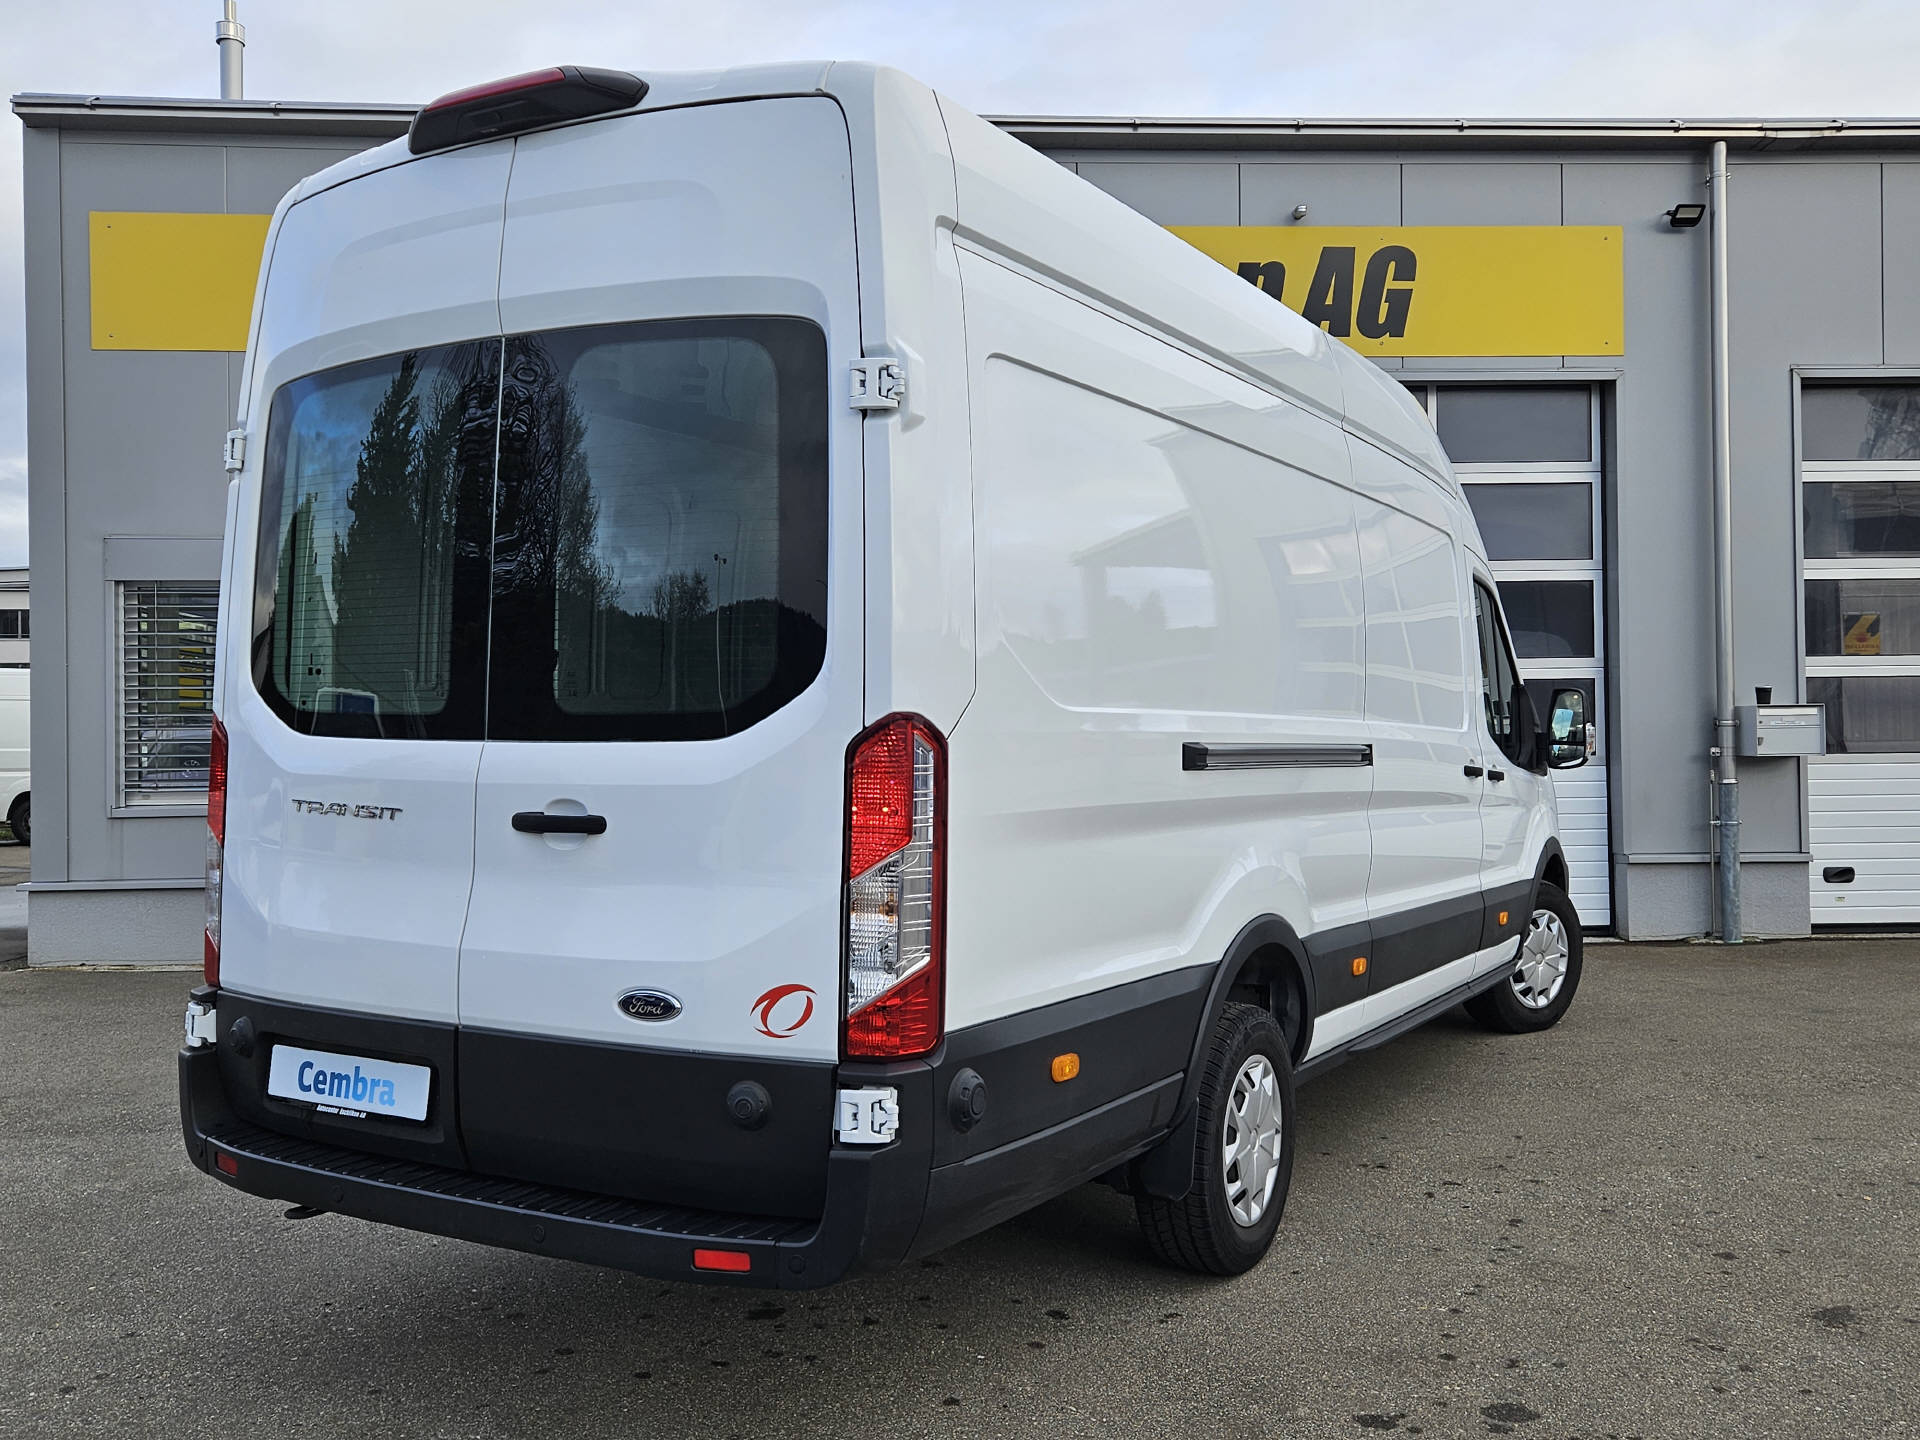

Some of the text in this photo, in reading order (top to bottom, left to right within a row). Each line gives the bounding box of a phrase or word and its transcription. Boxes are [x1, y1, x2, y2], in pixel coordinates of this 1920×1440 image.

[1300, 245, 1417, 340] AG
[291, 798, 404, 821] TRANSIT
[629, 995, 665, 1015] Ford
[297, 1060, 397, 1107] Cembra
